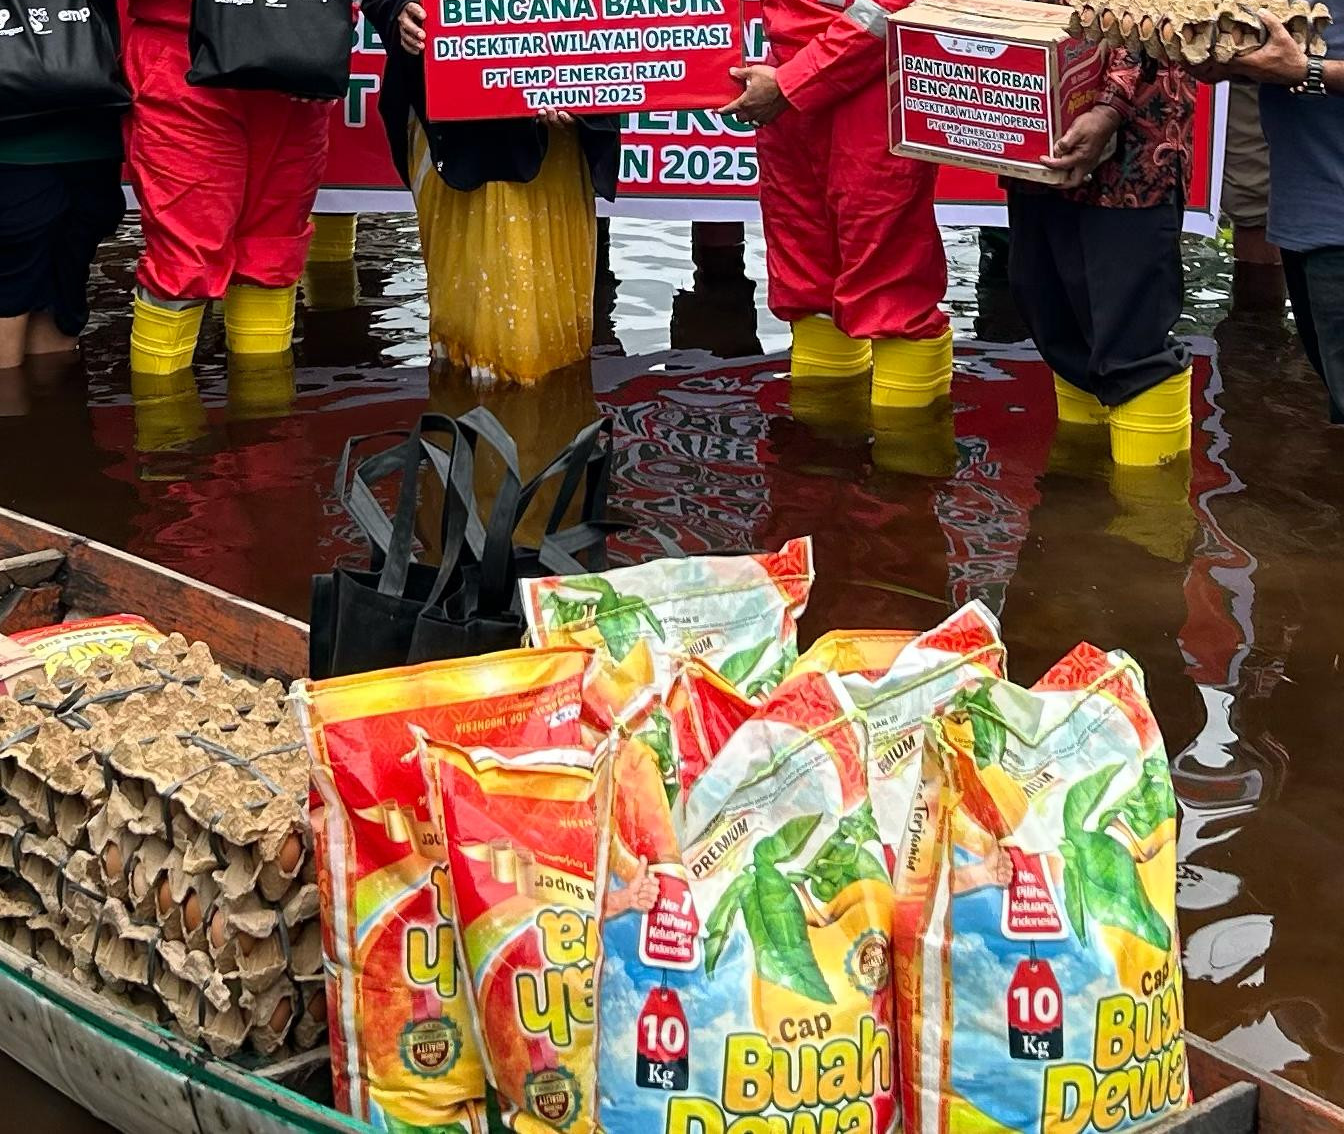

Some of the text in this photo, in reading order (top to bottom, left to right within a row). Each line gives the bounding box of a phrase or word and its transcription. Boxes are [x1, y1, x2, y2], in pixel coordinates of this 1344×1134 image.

[57, 7, 91, 22] emp
[436, 40, 459, 59] DI
[465, 35, 546, 58] SEKITAR
[551, 30, 639, 54] WILAYAH
[646, 25, 731, 50] OPERASI
[976, 43, 996, 55] emp
[484, 62, 684, 87] PT EMP ENERGI RIAU
[904, 55, 975, 81] BANTUAN
[979, 69, 1045, 93] KORBAN
[527, 87, 644, 107] TAHUN 2025
[908, 77, 981, 104] BENCANA
[984, 90, 1041, 113] BANJIR
[905, 97, 1047, 130] DI SEKITAR WILAYAH OPERASI
[941, 120, 961, 134] EMP
[962, 123, 998, 140] ENERGI
[999, 131, 1024, 144] RIAU
[947, 133, 1004, 153] TAHUN 2025
[663, 149, 759, 182] 2025
[455, 716, 506, 735] INDONESIA
[692, 817, 749, 878] PREMIUM
[534, 874, 584, 899] Super
[681, 890, 692, 915] 1
[1012, 986, 1059, 1024] 10
[641, 1013, 685, 1054] 10
[779, 1011, 833, 1044] Cap
[1022, 1033, 1050, 1059] Kg
[646, 1063, 675, 1089] Kg
[722, 1015, 891, 1113] Buah
